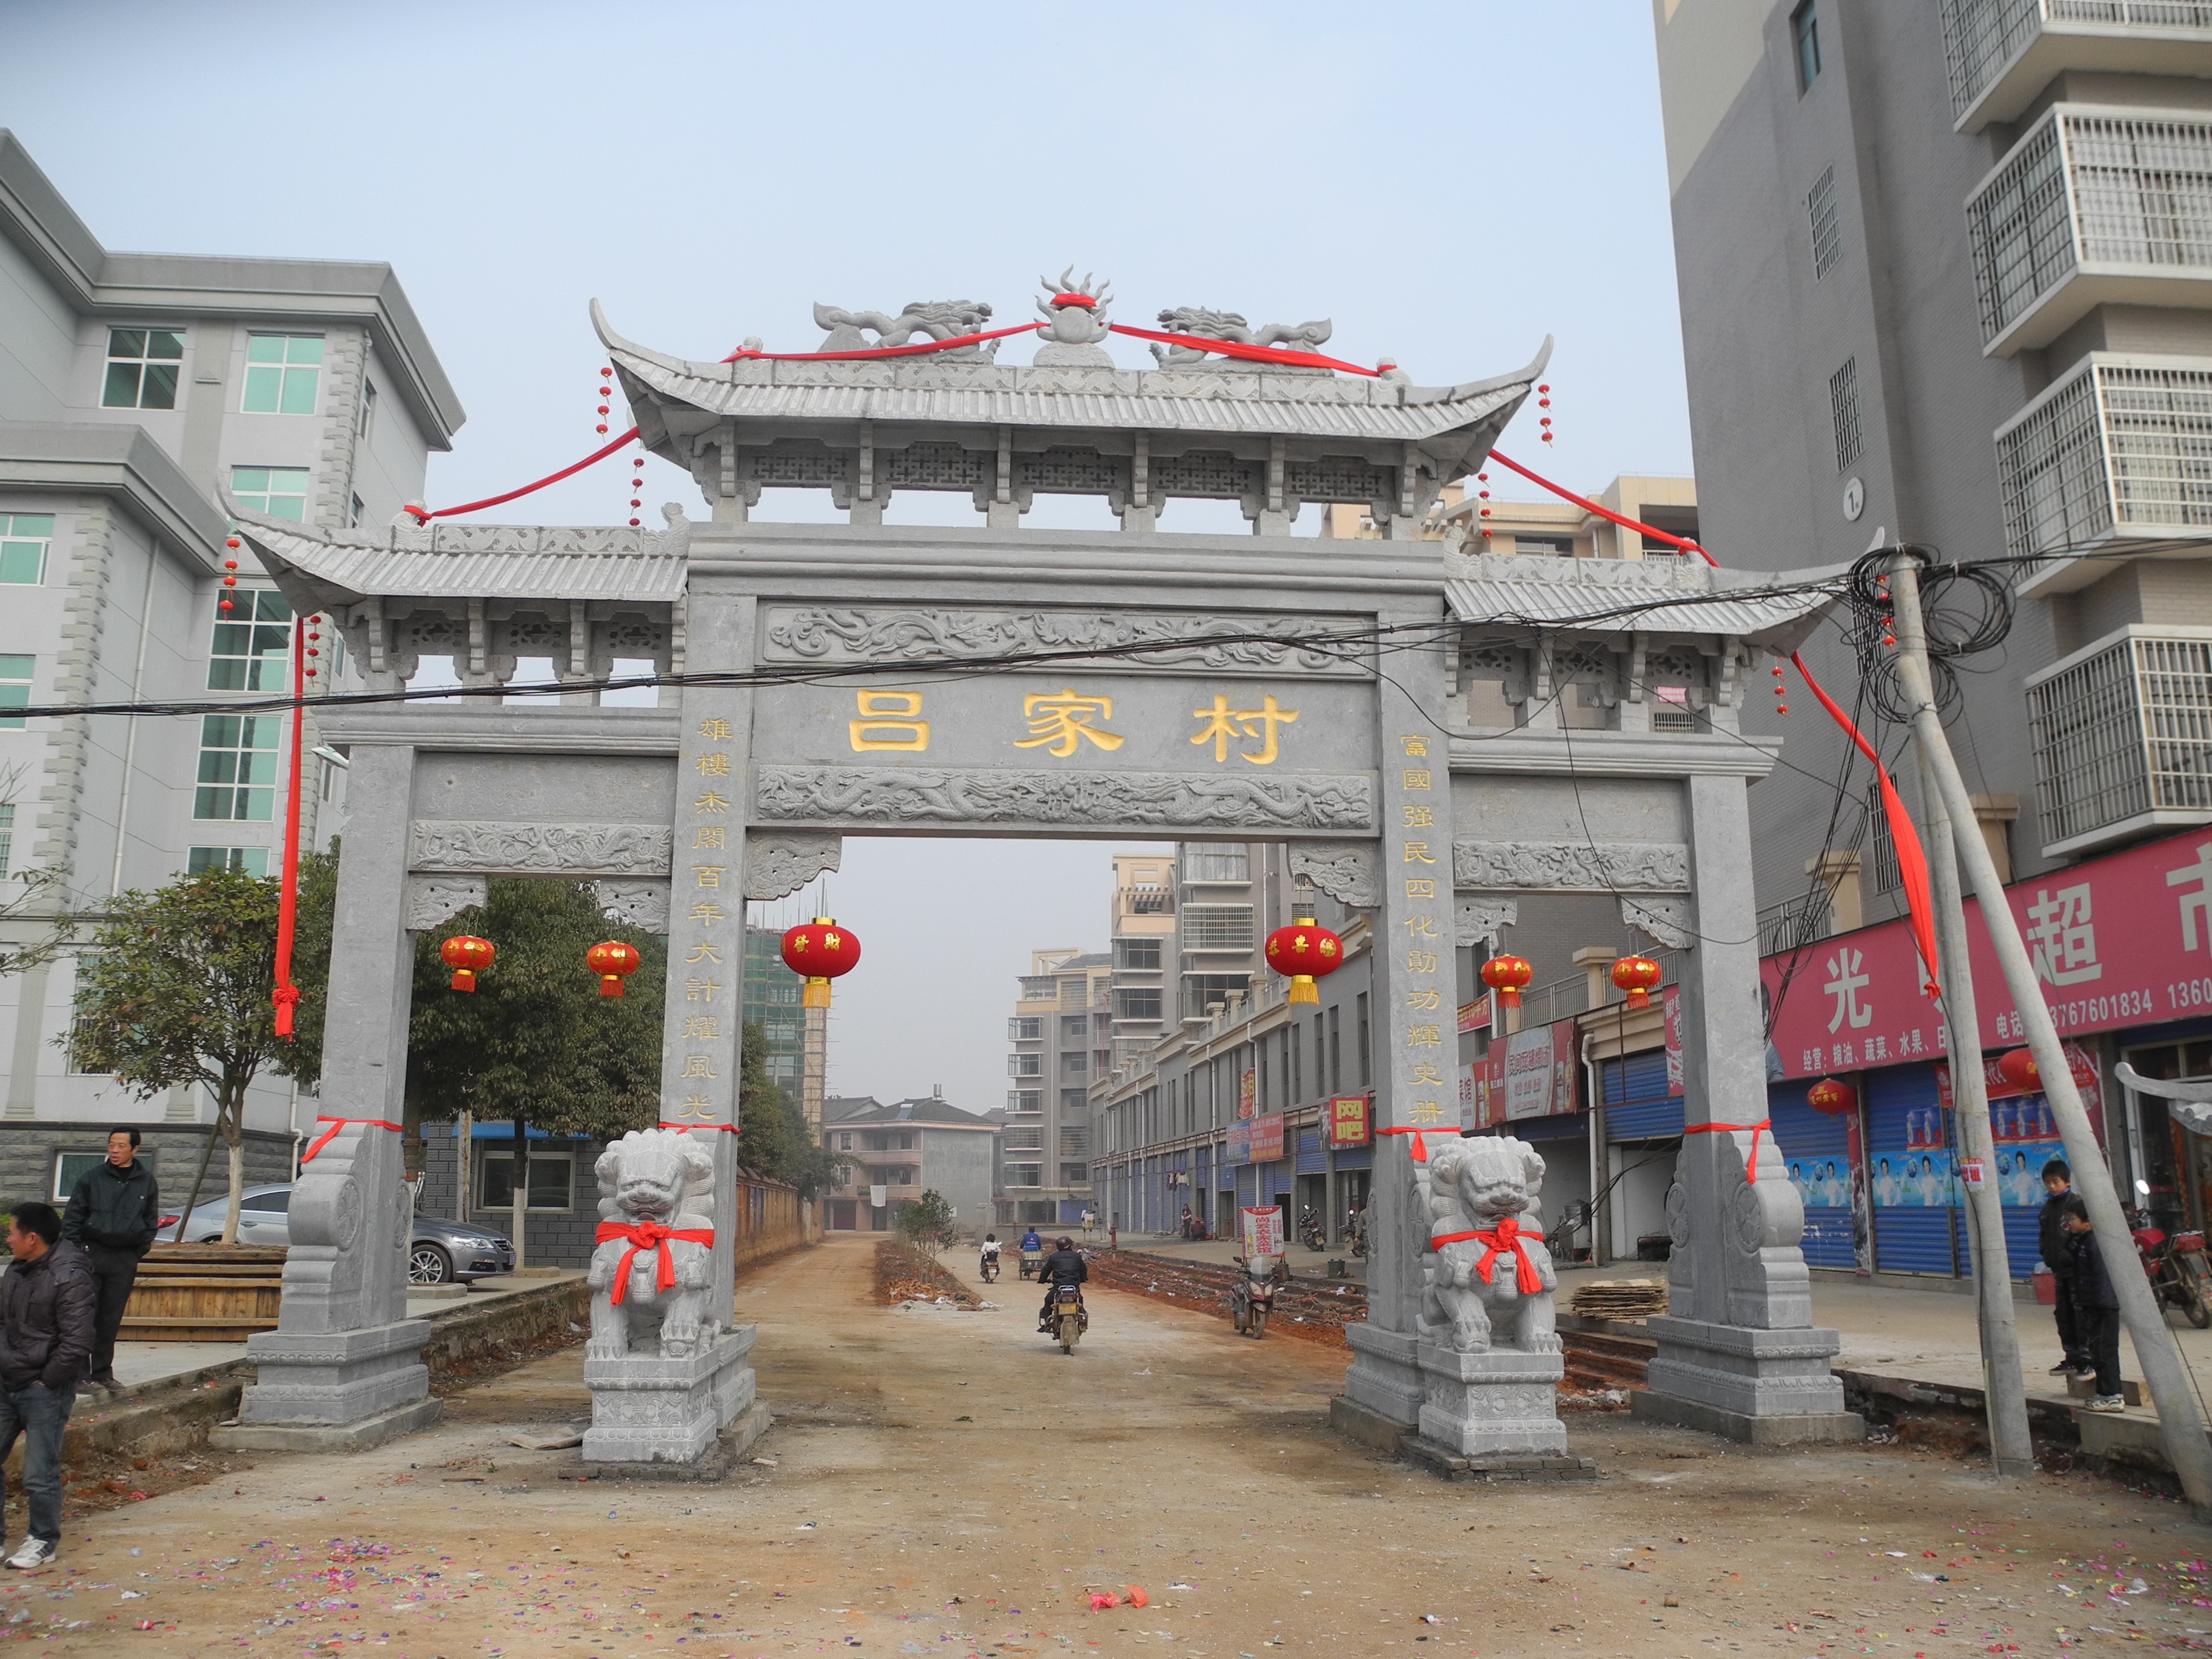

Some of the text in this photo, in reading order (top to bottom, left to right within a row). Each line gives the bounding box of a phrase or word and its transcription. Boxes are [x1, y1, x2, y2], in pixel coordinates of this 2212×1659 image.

[849, 688, 1300, 765] 吕家村
[1824, 841, 2212, 1034] 光超市
[2049, 988, 2153, 1029] 3767601834
[1336, 1100, 1364, 1141] 网吧
